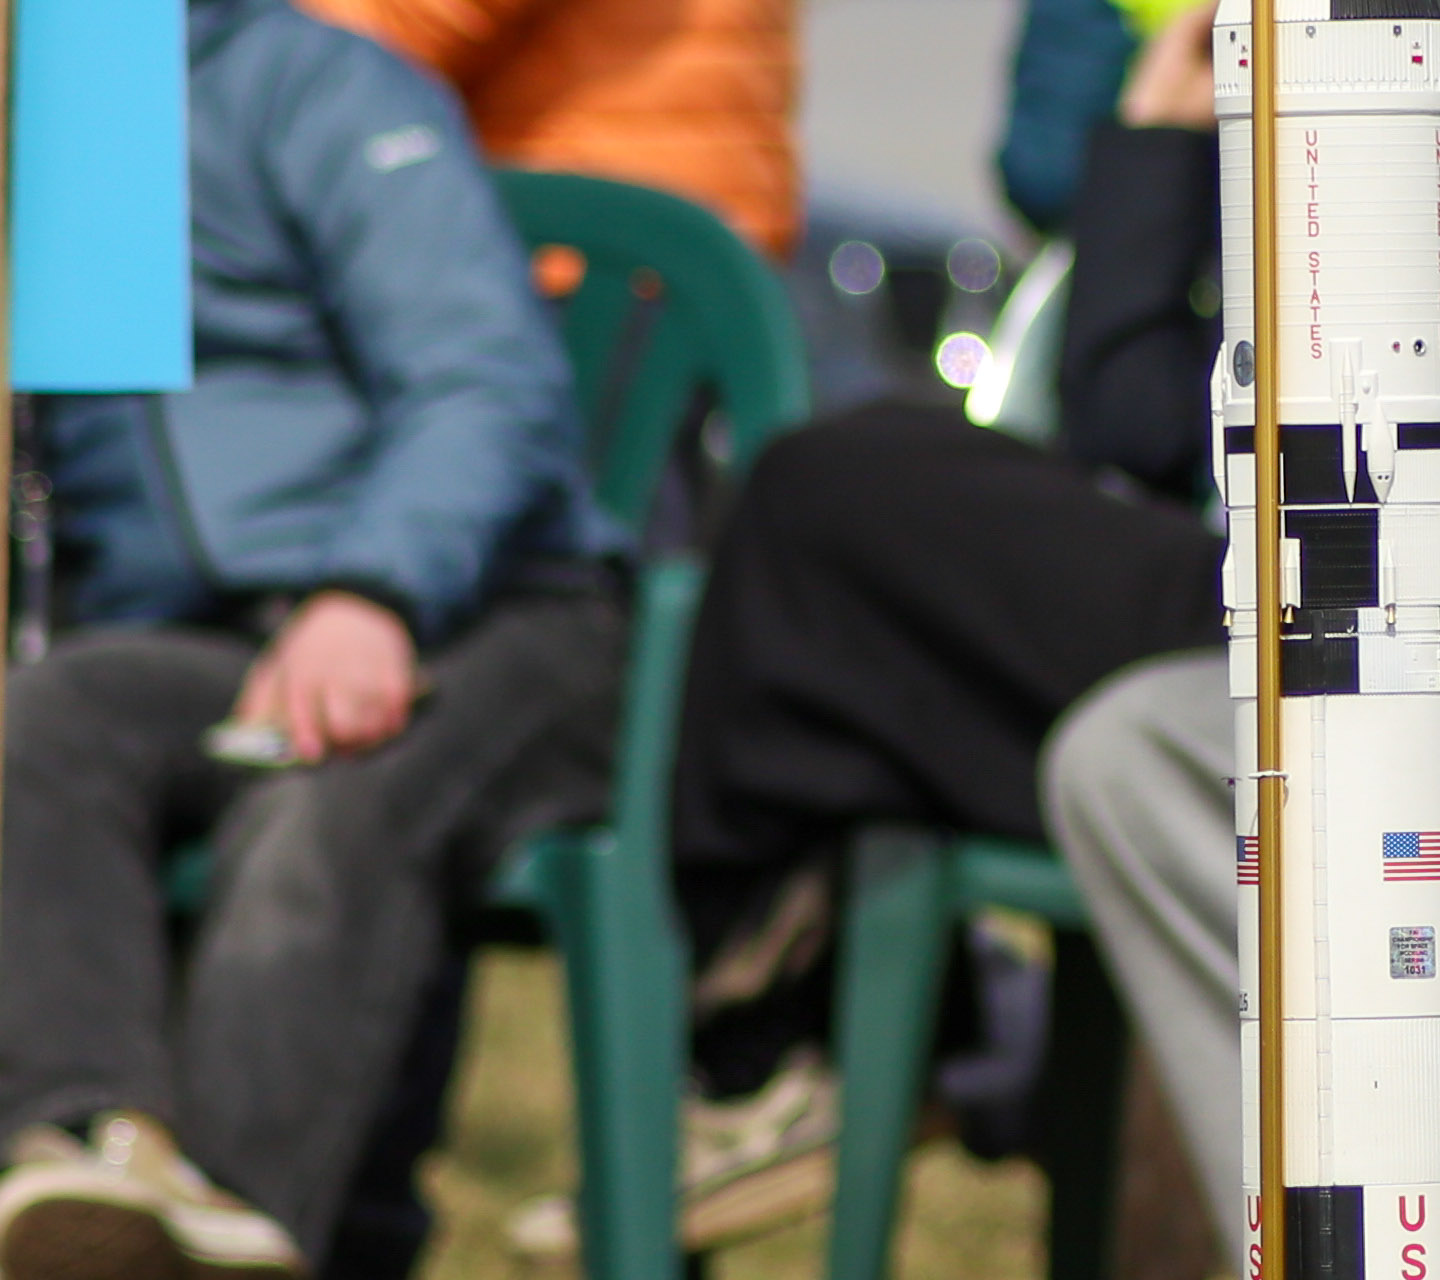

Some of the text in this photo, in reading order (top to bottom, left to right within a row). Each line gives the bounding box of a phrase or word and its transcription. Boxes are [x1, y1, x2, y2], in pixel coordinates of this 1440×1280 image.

[1305, 130, 1322, 359] UNITED STATES
[1404, 965, 1426, 975] 1031
